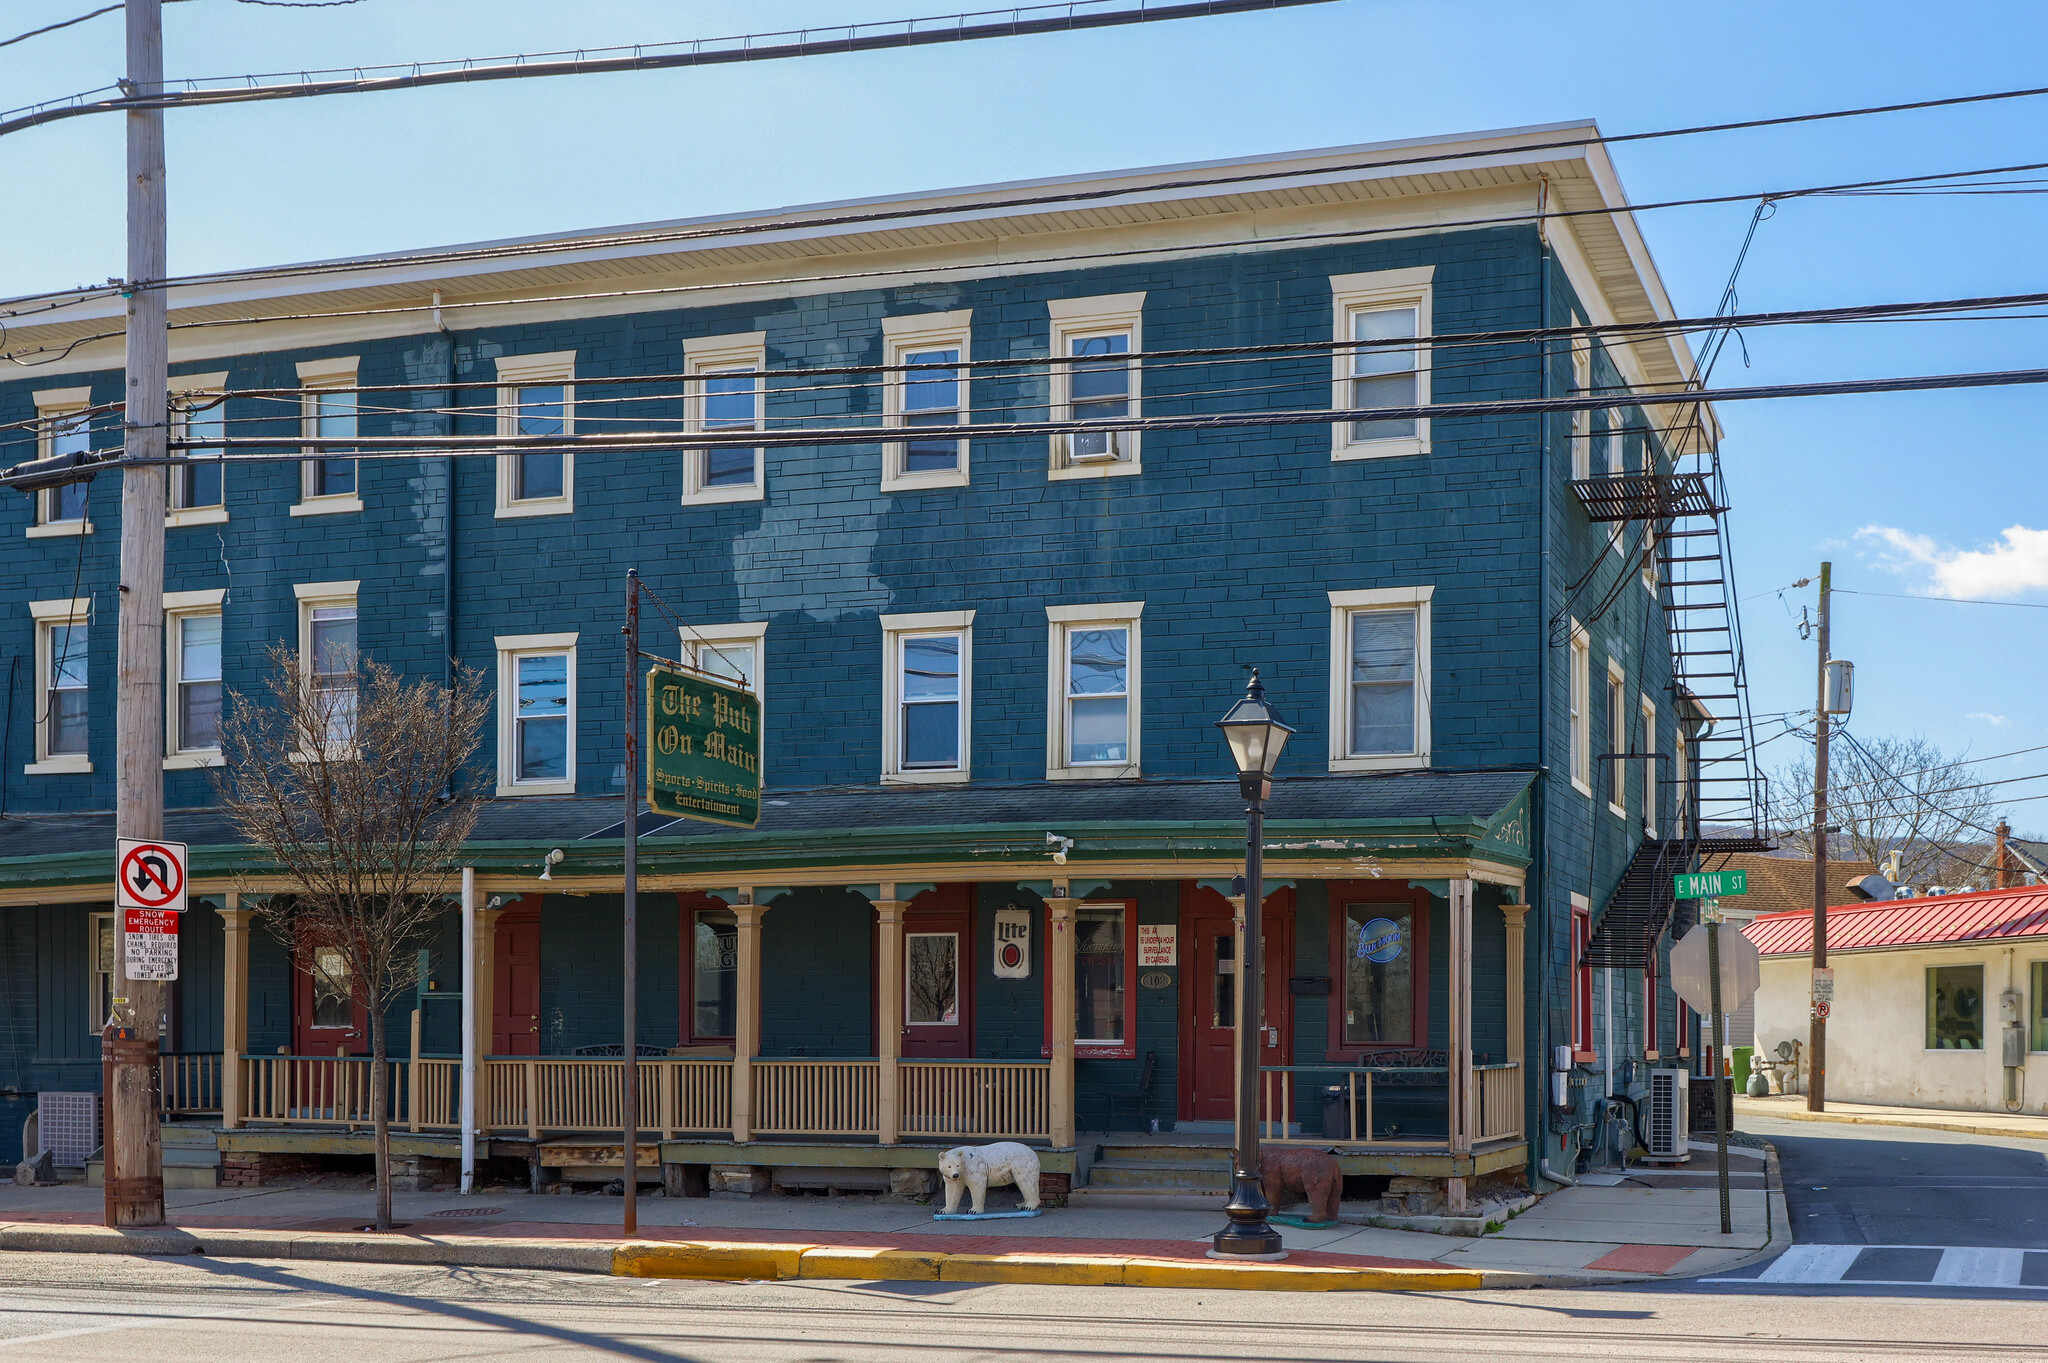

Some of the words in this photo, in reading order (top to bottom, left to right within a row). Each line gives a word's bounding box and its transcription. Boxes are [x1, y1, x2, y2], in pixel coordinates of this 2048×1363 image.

[661, 685, 702, 722] The
[712, 691, 752, 734] Pub
[657, 725, 693, 755] On
[703, 730, 757, 774] Main
[655, 768, 691, 787] Sports
[695, 775, 731, 795] Spirits
[735, 783, 758, 800] Food
[674, 791, 741, 816] Entertainment
[1678, 880, 1684, 894] E
[1689, 874, 1722, 896] MAIN
[1731, 875, 1743, 890] ST
[139, 910, 165, 918] SNOW
[128, 917, 175, 926] EMERGENCY
[139, 925, 165, 934] ROUTE
[997, 922, 1027, 943] Lite
[1141, 927, 1150, 935] THIS
[148, 933, 164, 941] TIRES
[1163, 936, 1175, 944] HOUR
[126, 940, 147, 948] CHAINS
[151, 941, 177, 949] REQUIRED
[130, 948, 141, 956] NO
[144, 948, 173, 957] PARKING
[1143, 946, 1172, 954] SURVEILLANCE
[126, 956, 145, 964] DURING
[148, 956, 177, 965] EMERGENCY
[1145, 956, 1150, 964] BY
[1151, 955, 1170, 964] CAMERAS
[140, 964, 165, 972] VEHICLES
[133, 971, 152, 979] TOWED
